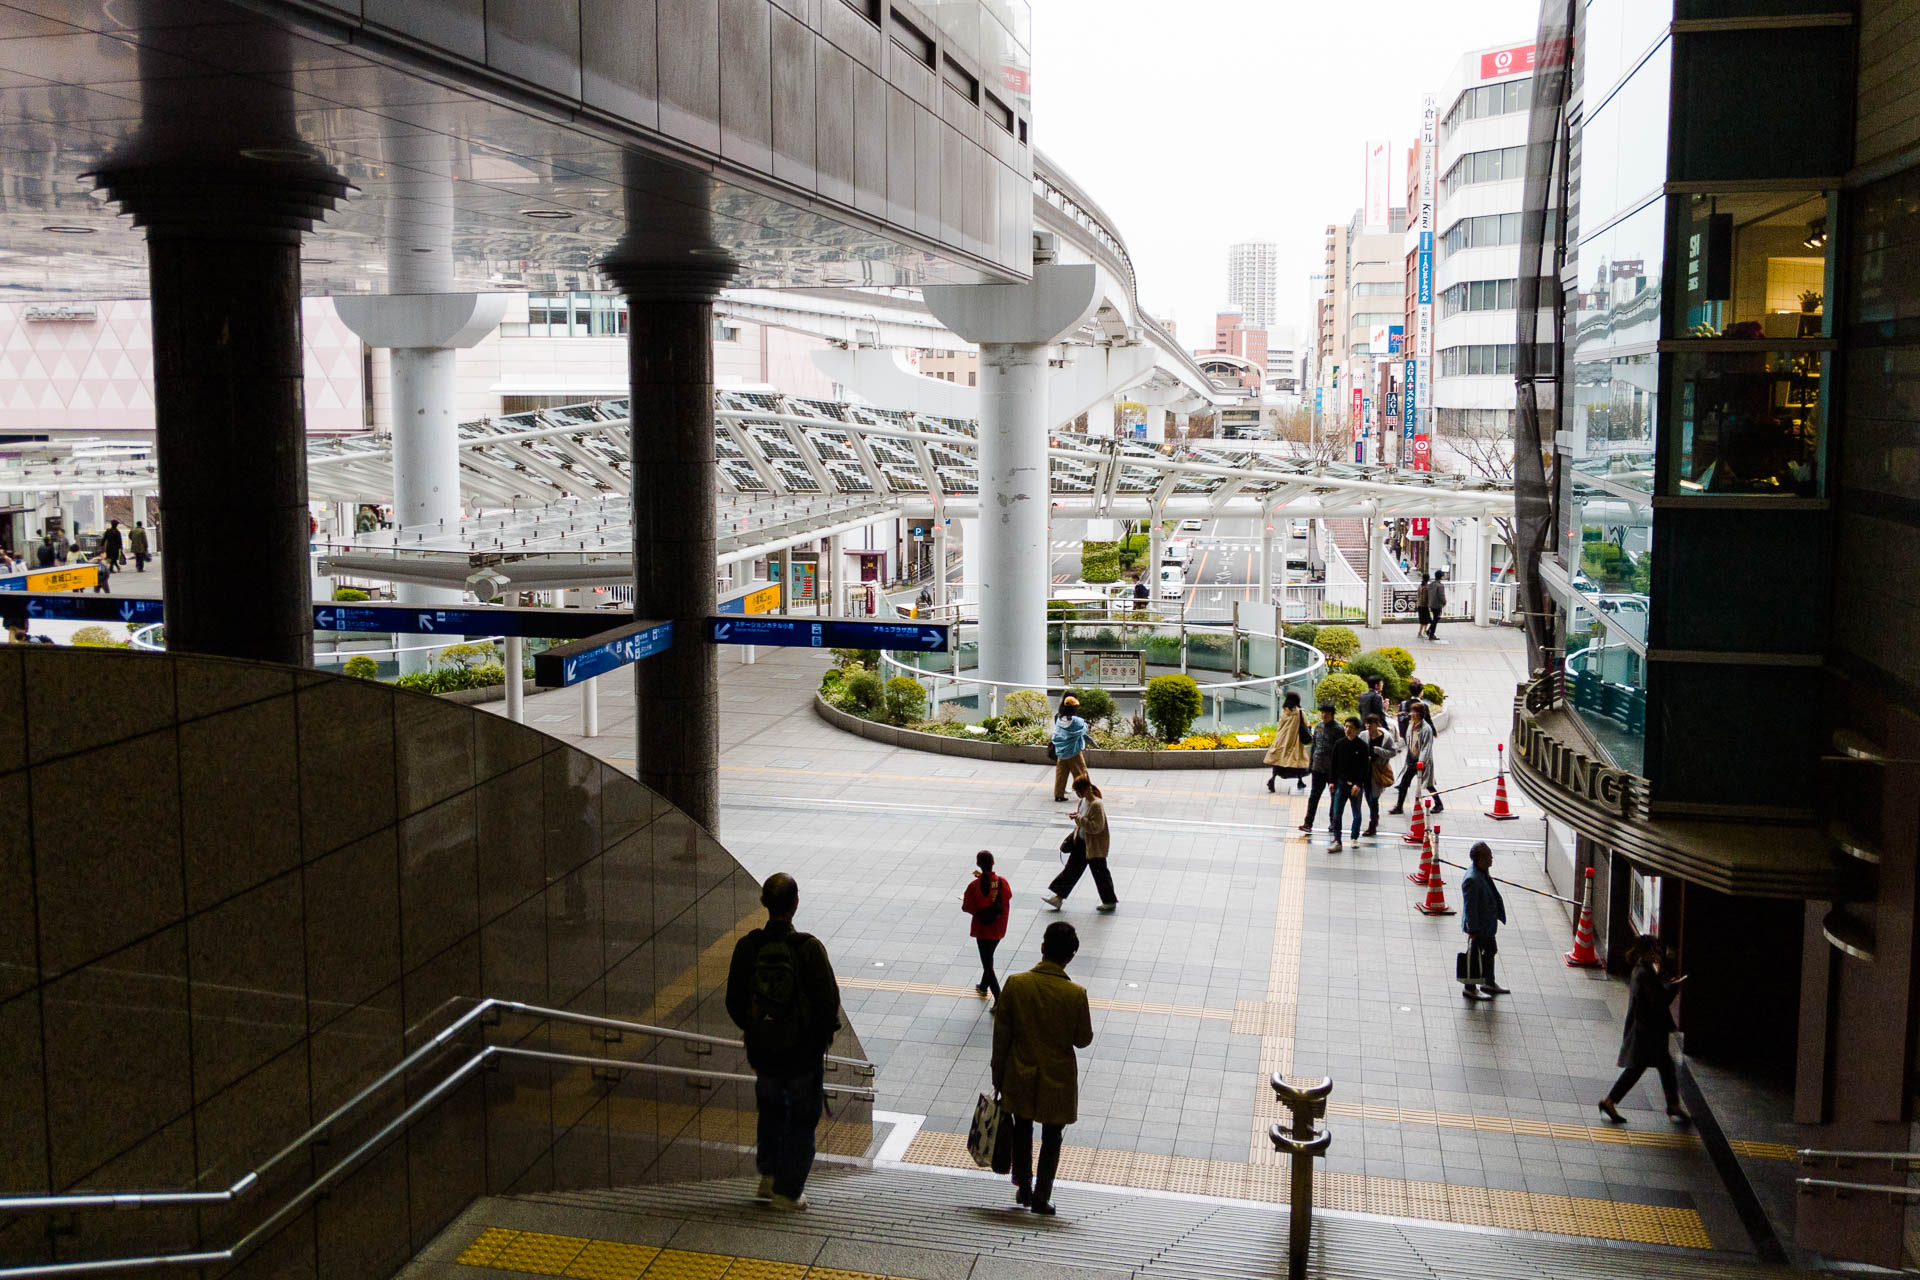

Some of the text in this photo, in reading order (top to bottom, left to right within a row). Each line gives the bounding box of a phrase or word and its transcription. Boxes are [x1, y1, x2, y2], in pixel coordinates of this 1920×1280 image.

[1424, 96, 1435, 143] 小倉ビル
[1407, 361, 1415, 383] AGA
[1389, 393, 1397, 416] AGA
[1405, 389, 1415, 440] スキンクリニック
[915, 527, 922, 536] P
[735, 621, 794, 630] ステーションホテル小倉
[1517, 709, 1624, 810] DINING
